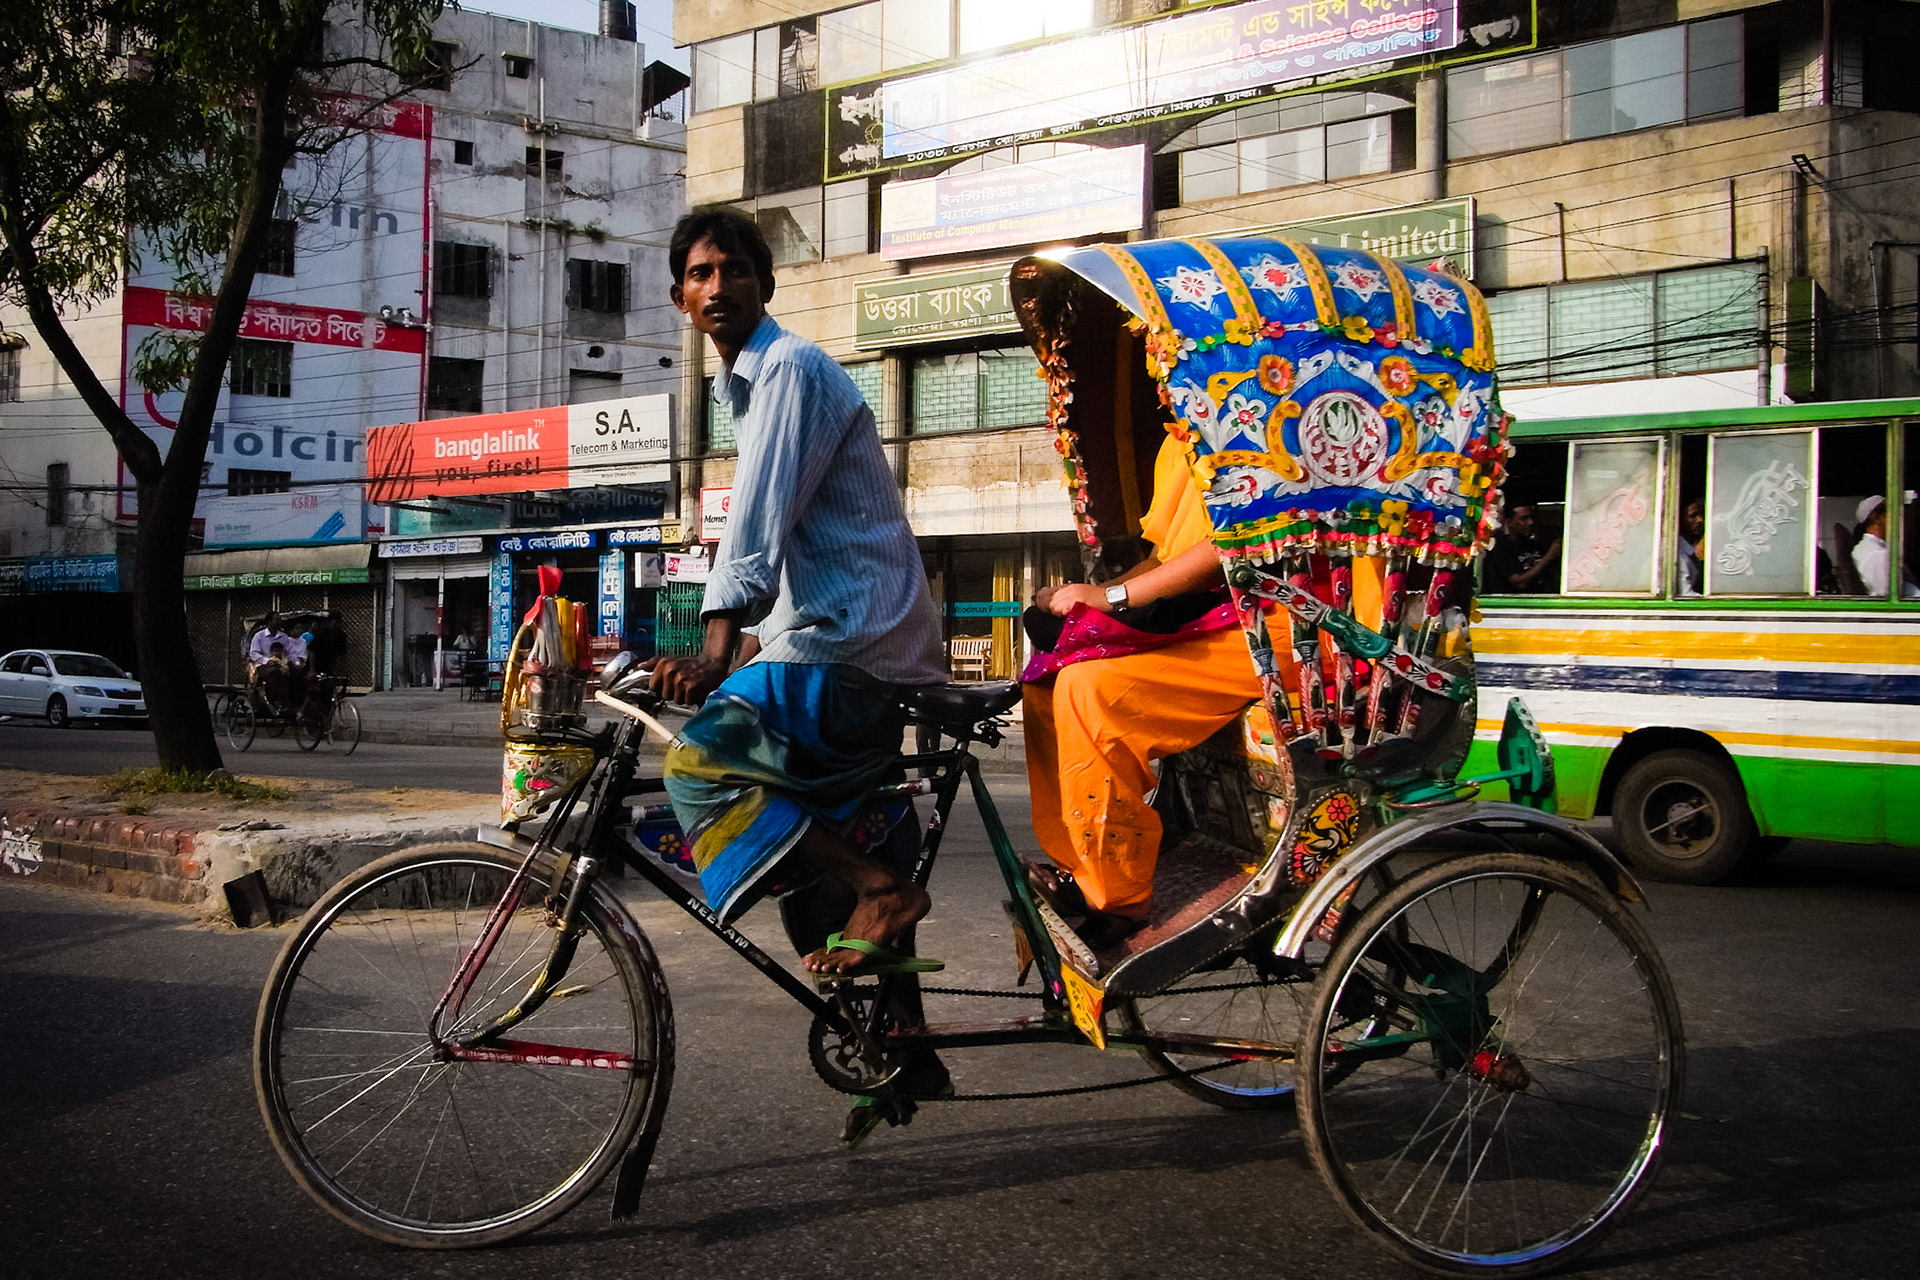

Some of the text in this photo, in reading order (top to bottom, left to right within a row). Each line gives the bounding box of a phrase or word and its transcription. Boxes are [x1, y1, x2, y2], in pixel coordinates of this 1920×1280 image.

[1261, 31, 1346, 58] Science
[1350, 8, 1439, 38] College
[891, 230, 932, 245] Institute
[934, 227, 945, 239] of
[947, 222, 997, 239] Computer
[999, 213, 1067, 232] Management
[863, 290, 922, 321] উত্তরা
[926, 282, 993, 316] ব্যাংক
[327, 314, 387, 344] সিমেট
[594, 408, 641, 436] S.A.
[435, 427, 540, 461] banglalink
[570, 436, 669, 456] Telecom & Marketing
[486, 456, 541, 480] first!
[291, 495, 318, 510] KSRM
